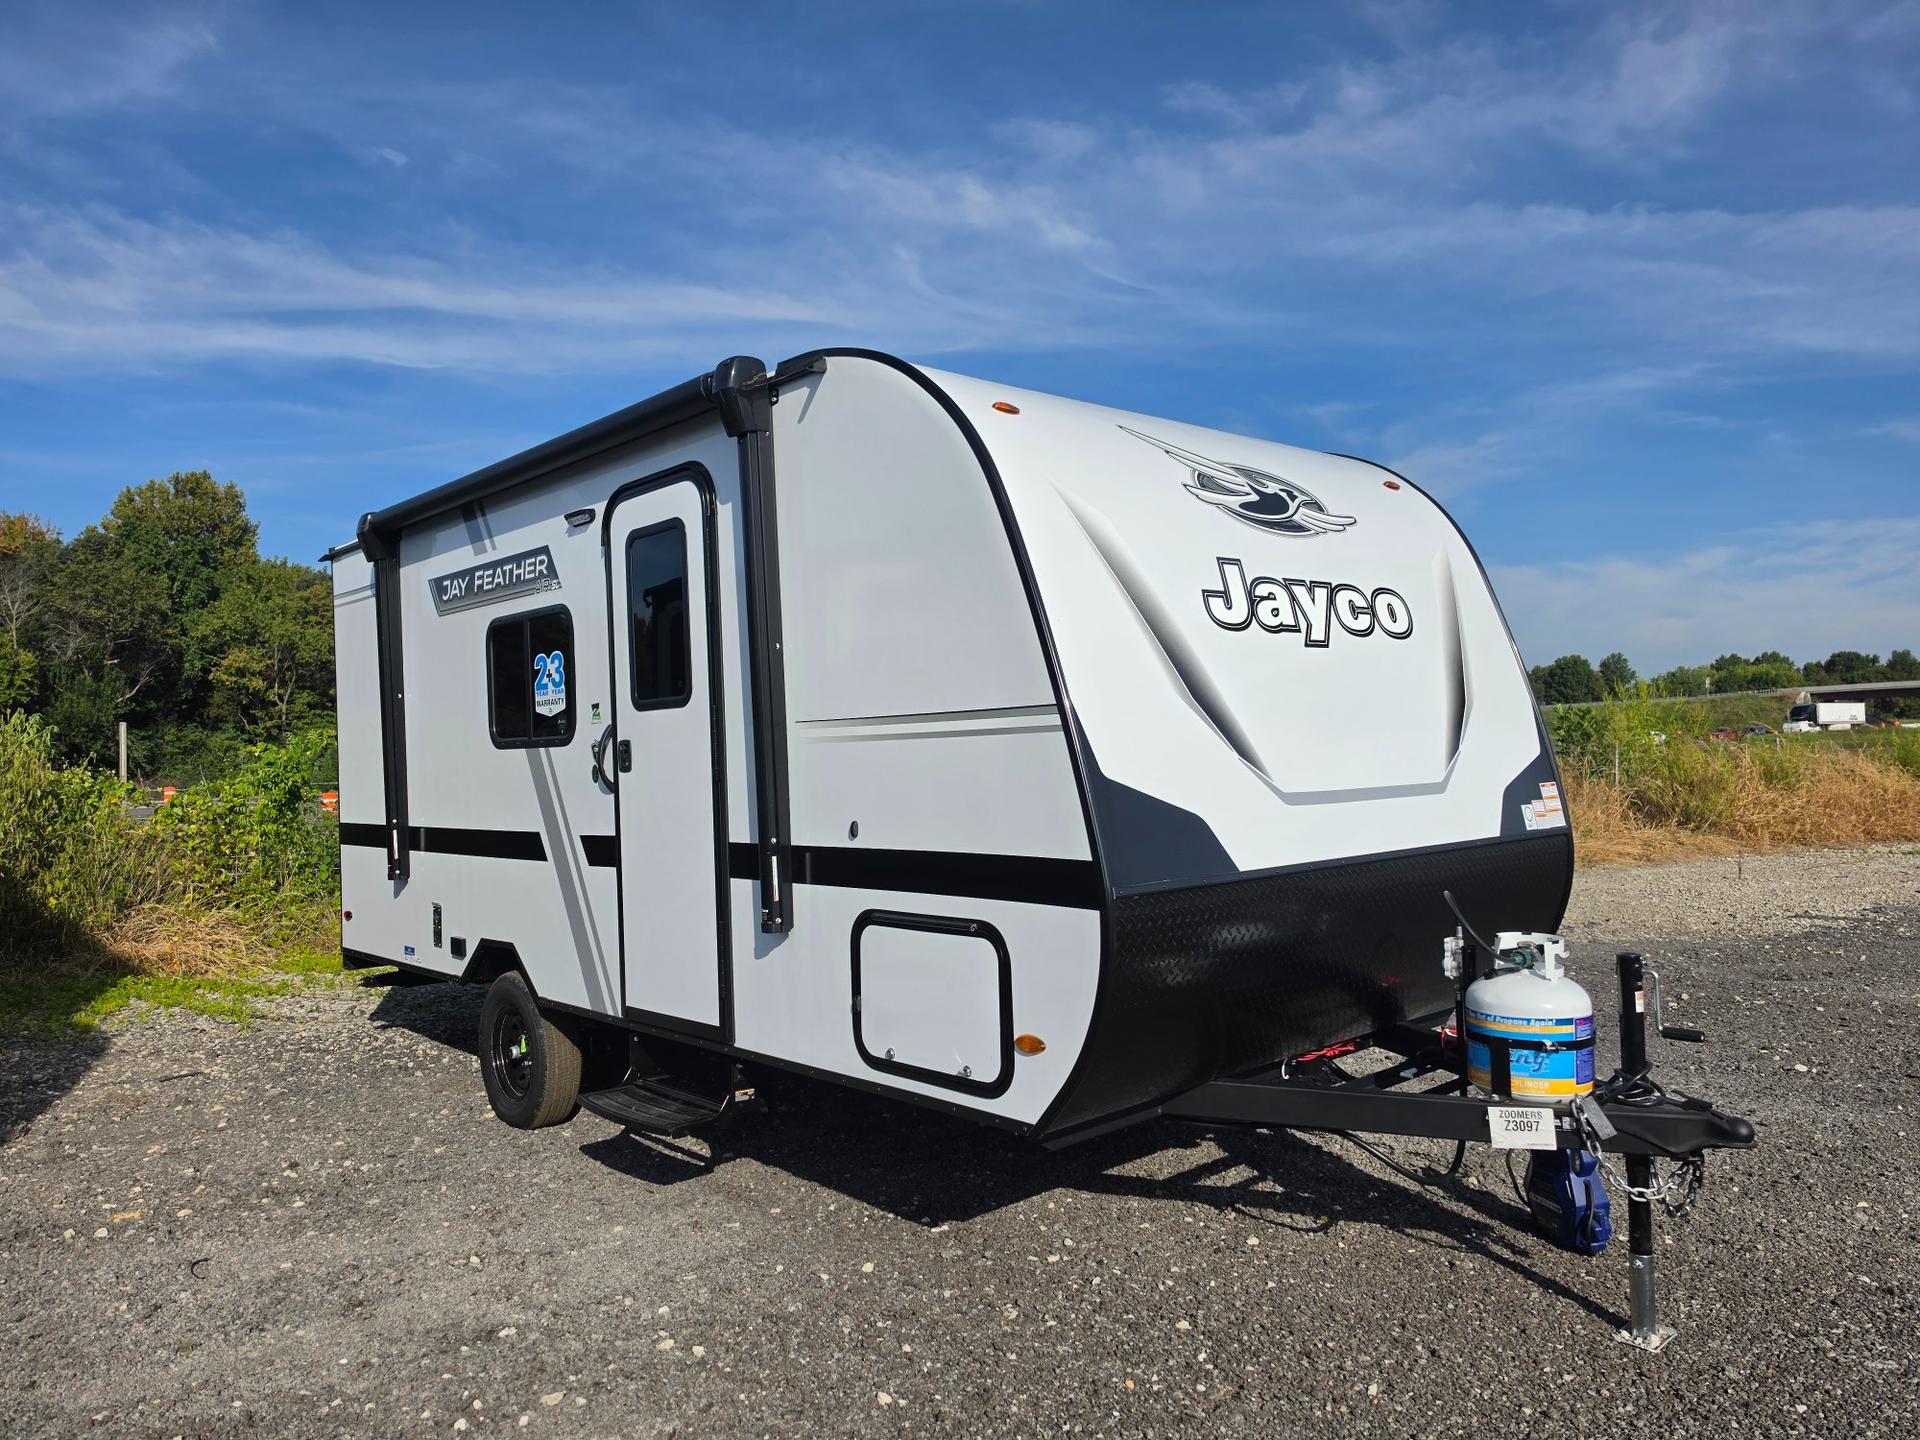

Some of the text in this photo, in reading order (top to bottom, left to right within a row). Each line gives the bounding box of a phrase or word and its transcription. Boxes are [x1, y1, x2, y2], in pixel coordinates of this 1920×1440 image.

[442, 555, 548, 600] JAY FEATHER
[1201, 556, 1413, 649] Jayco
[536, 697, 564, 707] WARRANTY
[1496, 1016, 1528, 1026] Propane
[1529, 1018, 1556, 1027] Again!
[1499, 1109, 1543, 1120] ZOOMERS
[1504, 1120, 1540, 1132] Z3097
